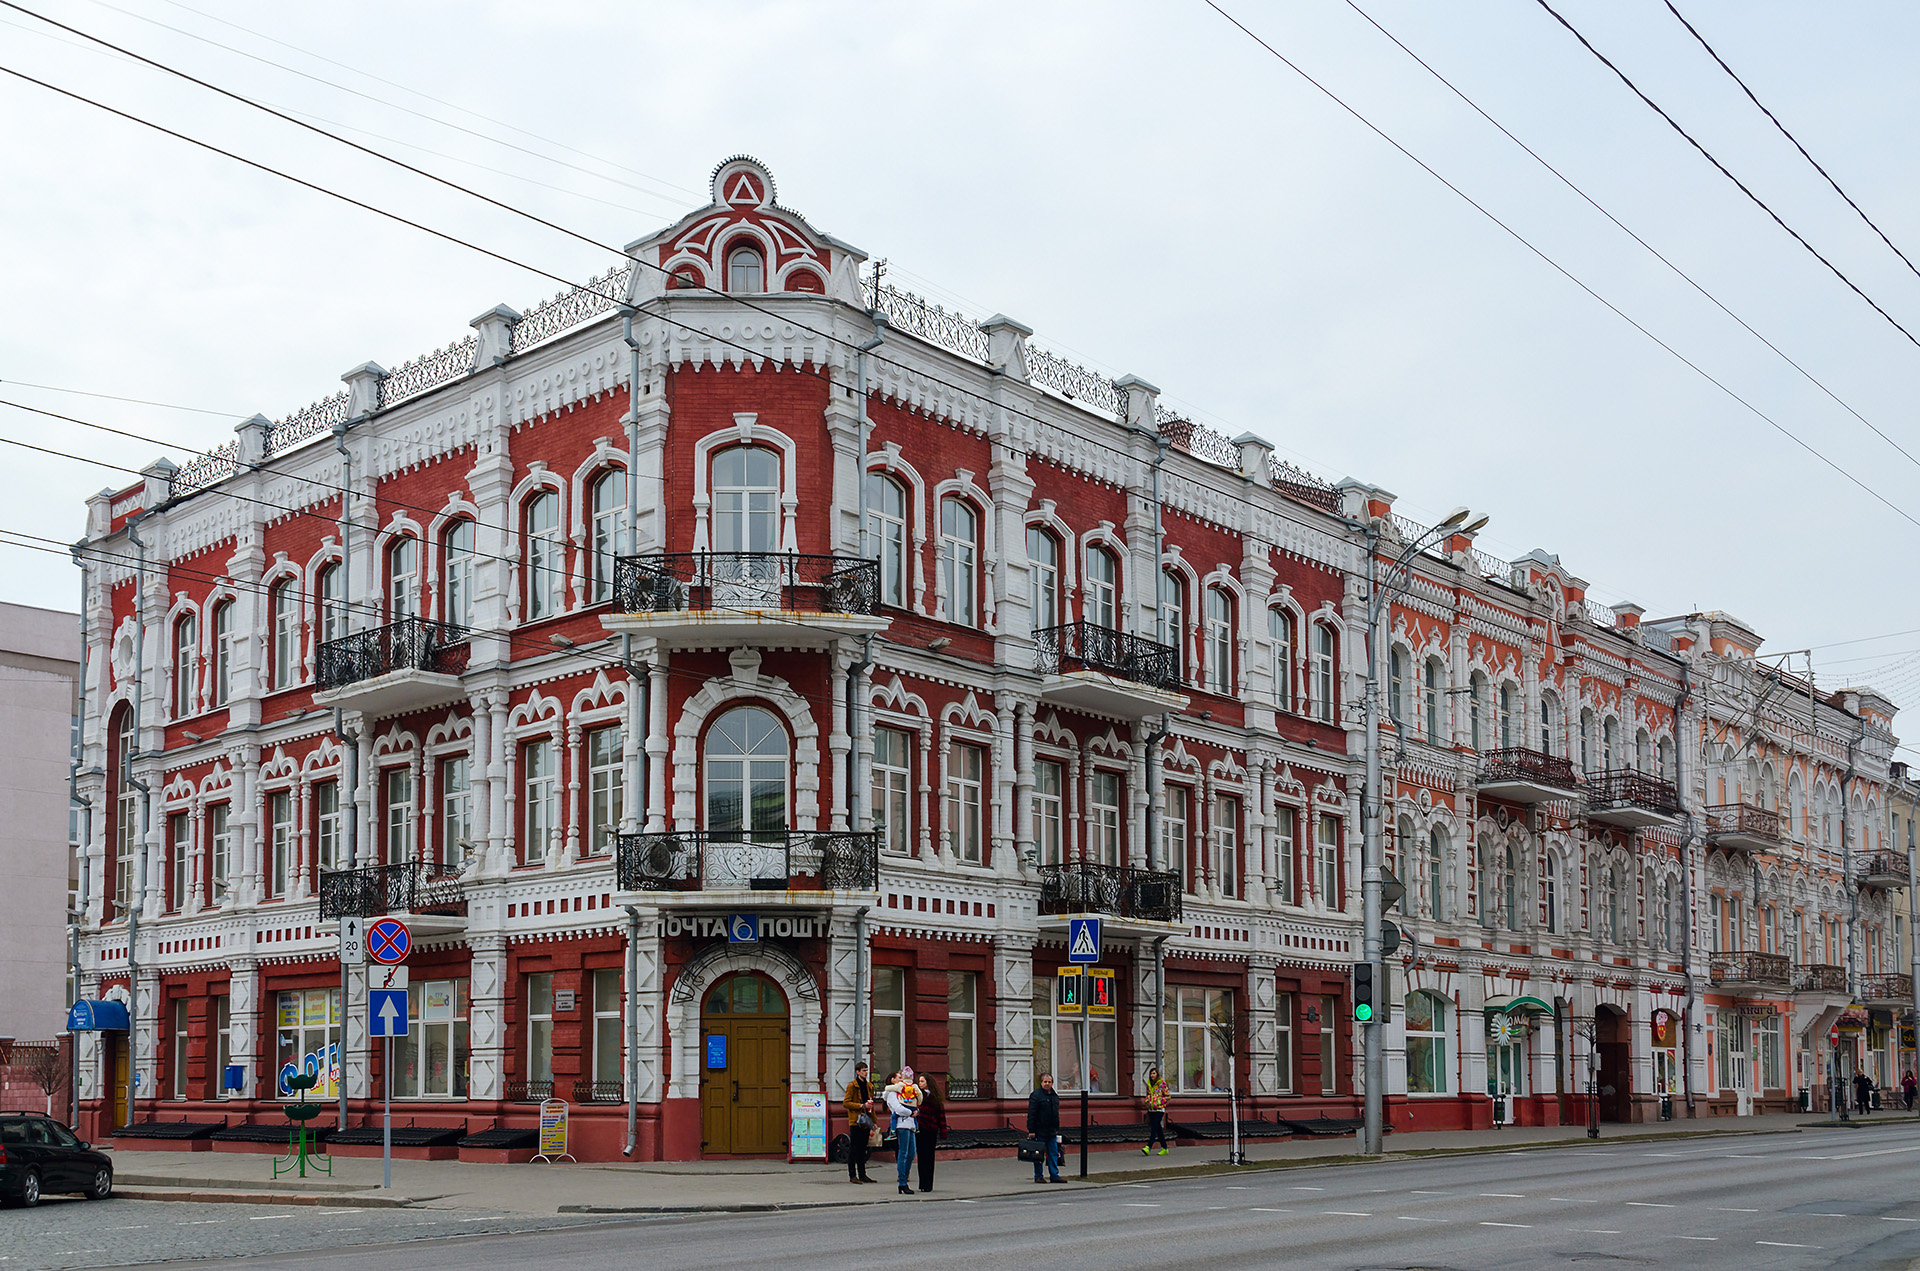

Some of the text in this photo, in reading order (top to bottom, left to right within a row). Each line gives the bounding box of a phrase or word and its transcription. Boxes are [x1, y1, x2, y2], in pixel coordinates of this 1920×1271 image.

[655, 918, 837, 938] ПОЧТА ПОШТА
[345, 941, 358, 951] 20
